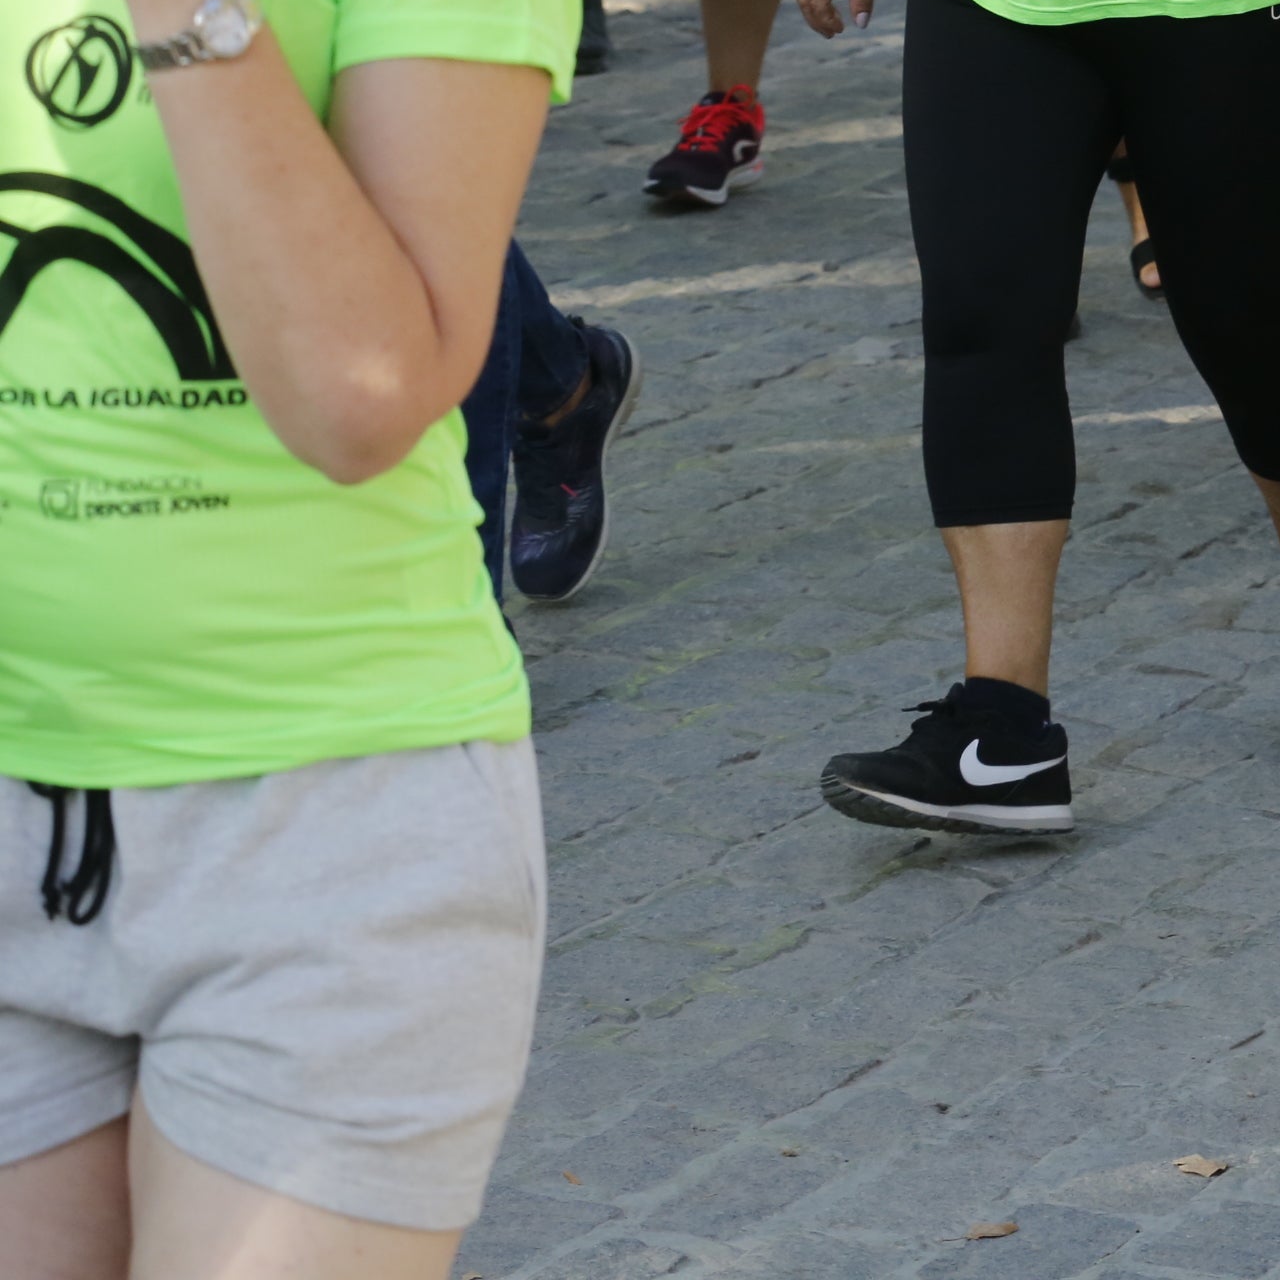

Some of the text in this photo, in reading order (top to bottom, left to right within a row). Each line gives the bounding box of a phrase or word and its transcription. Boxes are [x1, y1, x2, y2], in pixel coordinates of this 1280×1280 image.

[44, 389, 79, 407] LA
[90, 387, 249, 408] IGUALDAD
[171, 495, 230, 513] JOVEN
